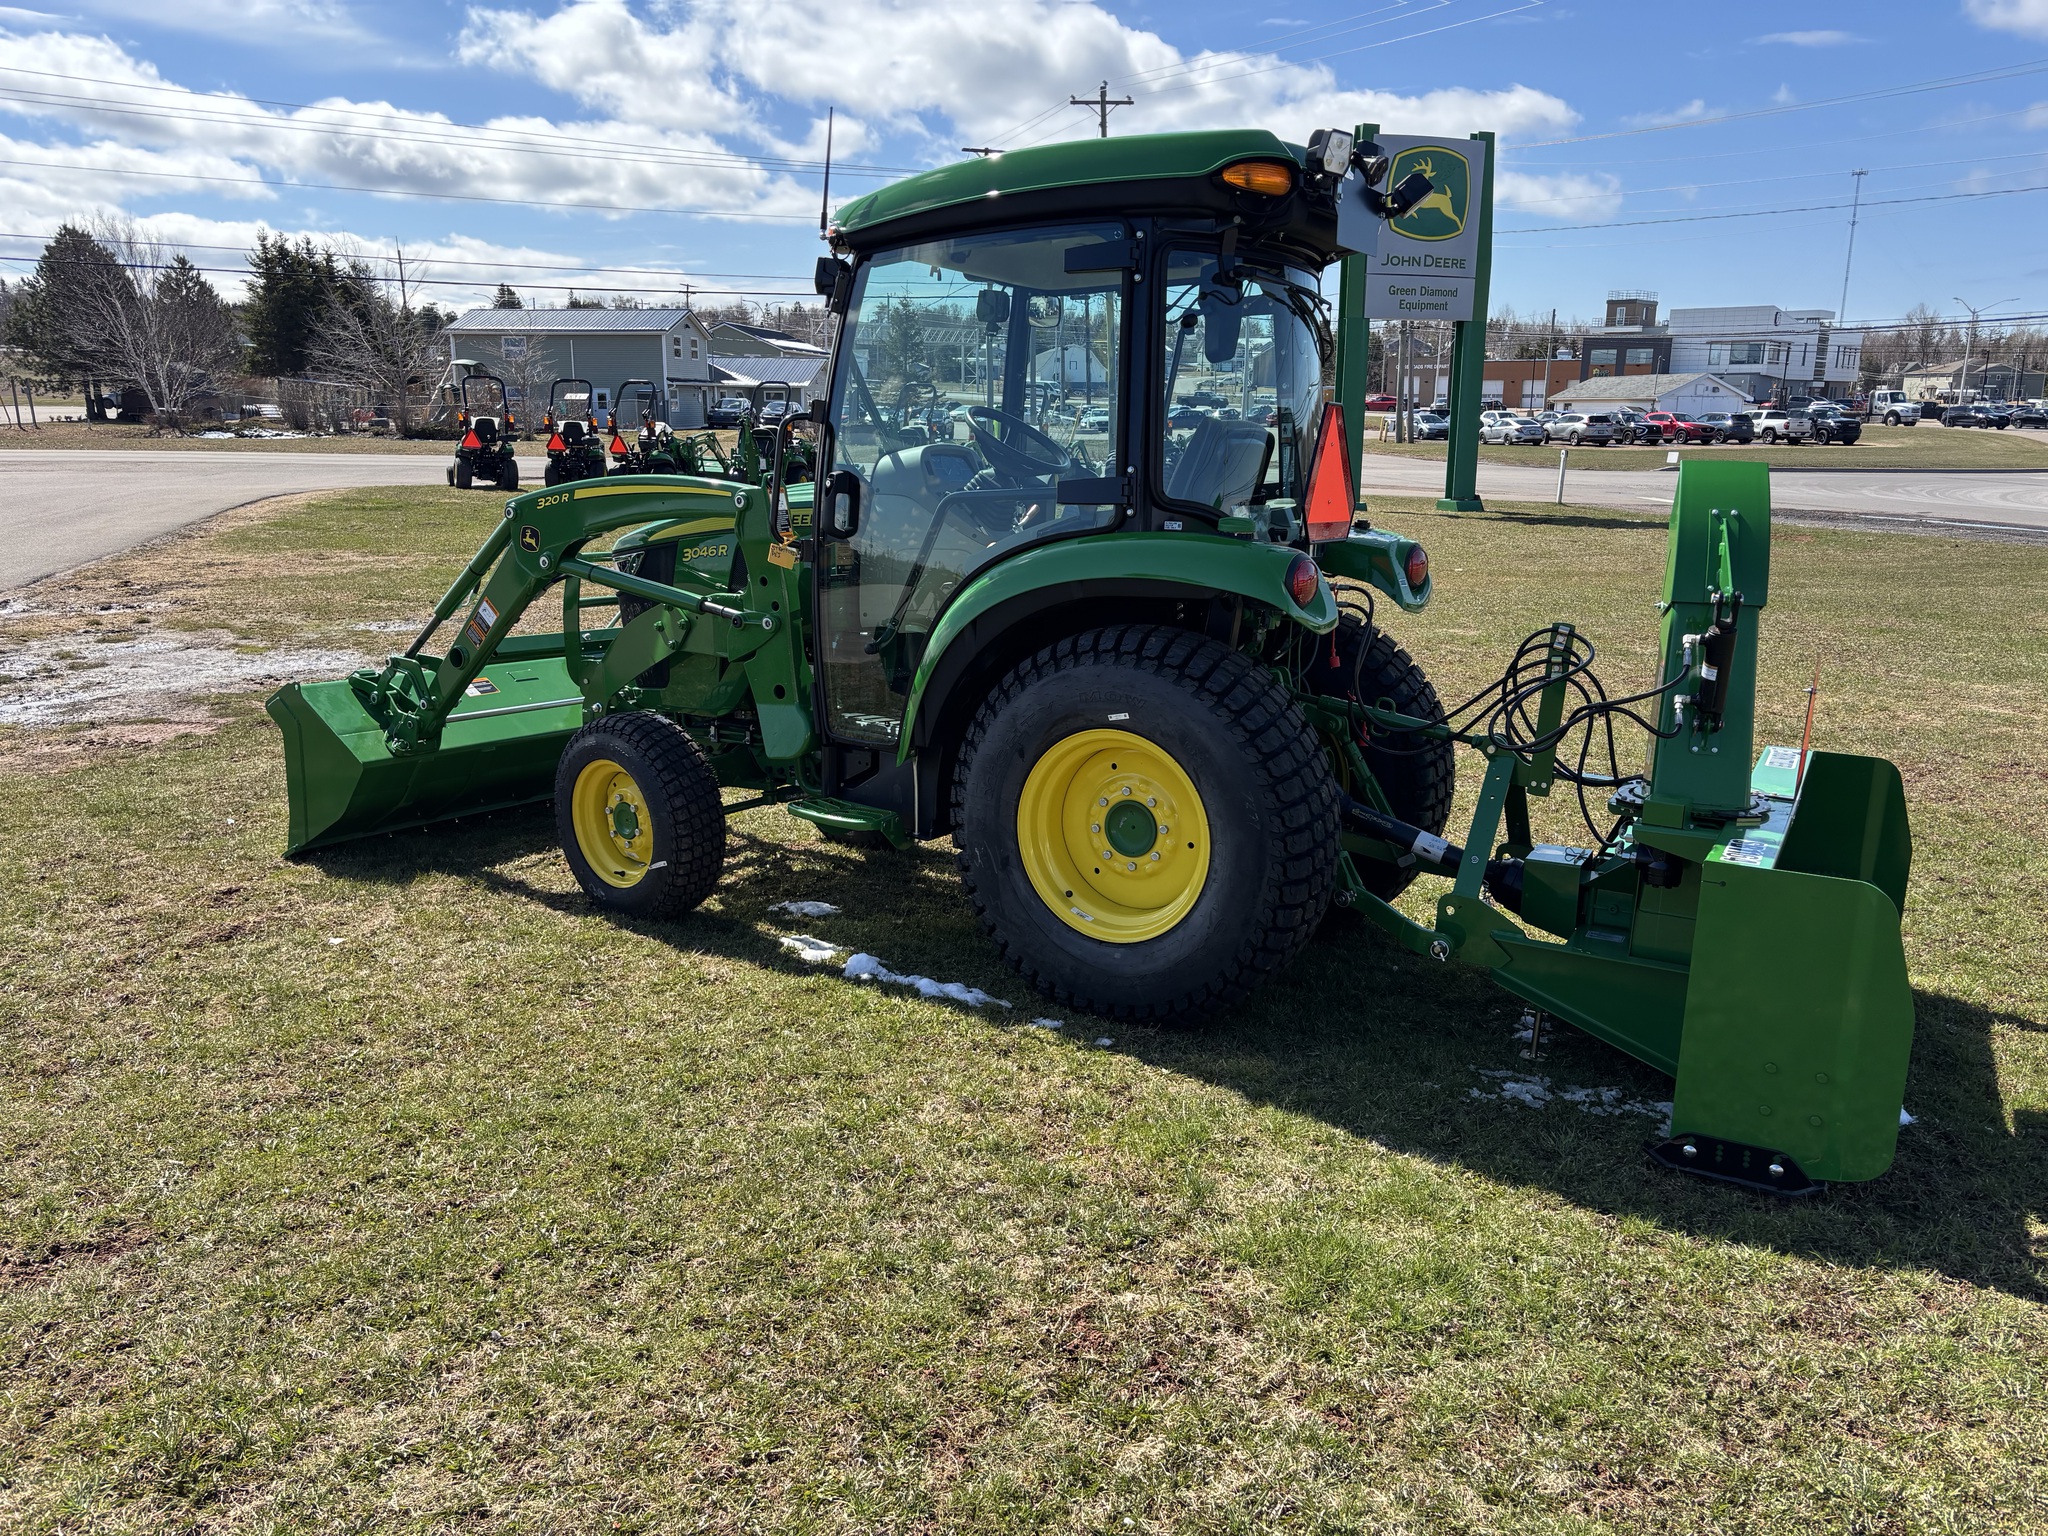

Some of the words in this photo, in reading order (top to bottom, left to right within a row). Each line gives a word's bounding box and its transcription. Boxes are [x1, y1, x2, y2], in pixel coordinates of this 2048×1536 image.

[1381, 254, 1421, 267] JOHN
[1424, 255, 1466, 269] DEERE
[1388, 285, 1416, 296] Green
[1420, 286, 1457, 297] Diamond
[1399, 300, 1448, 312] Equipment
[1078, 690, 1147, 710] MOW
